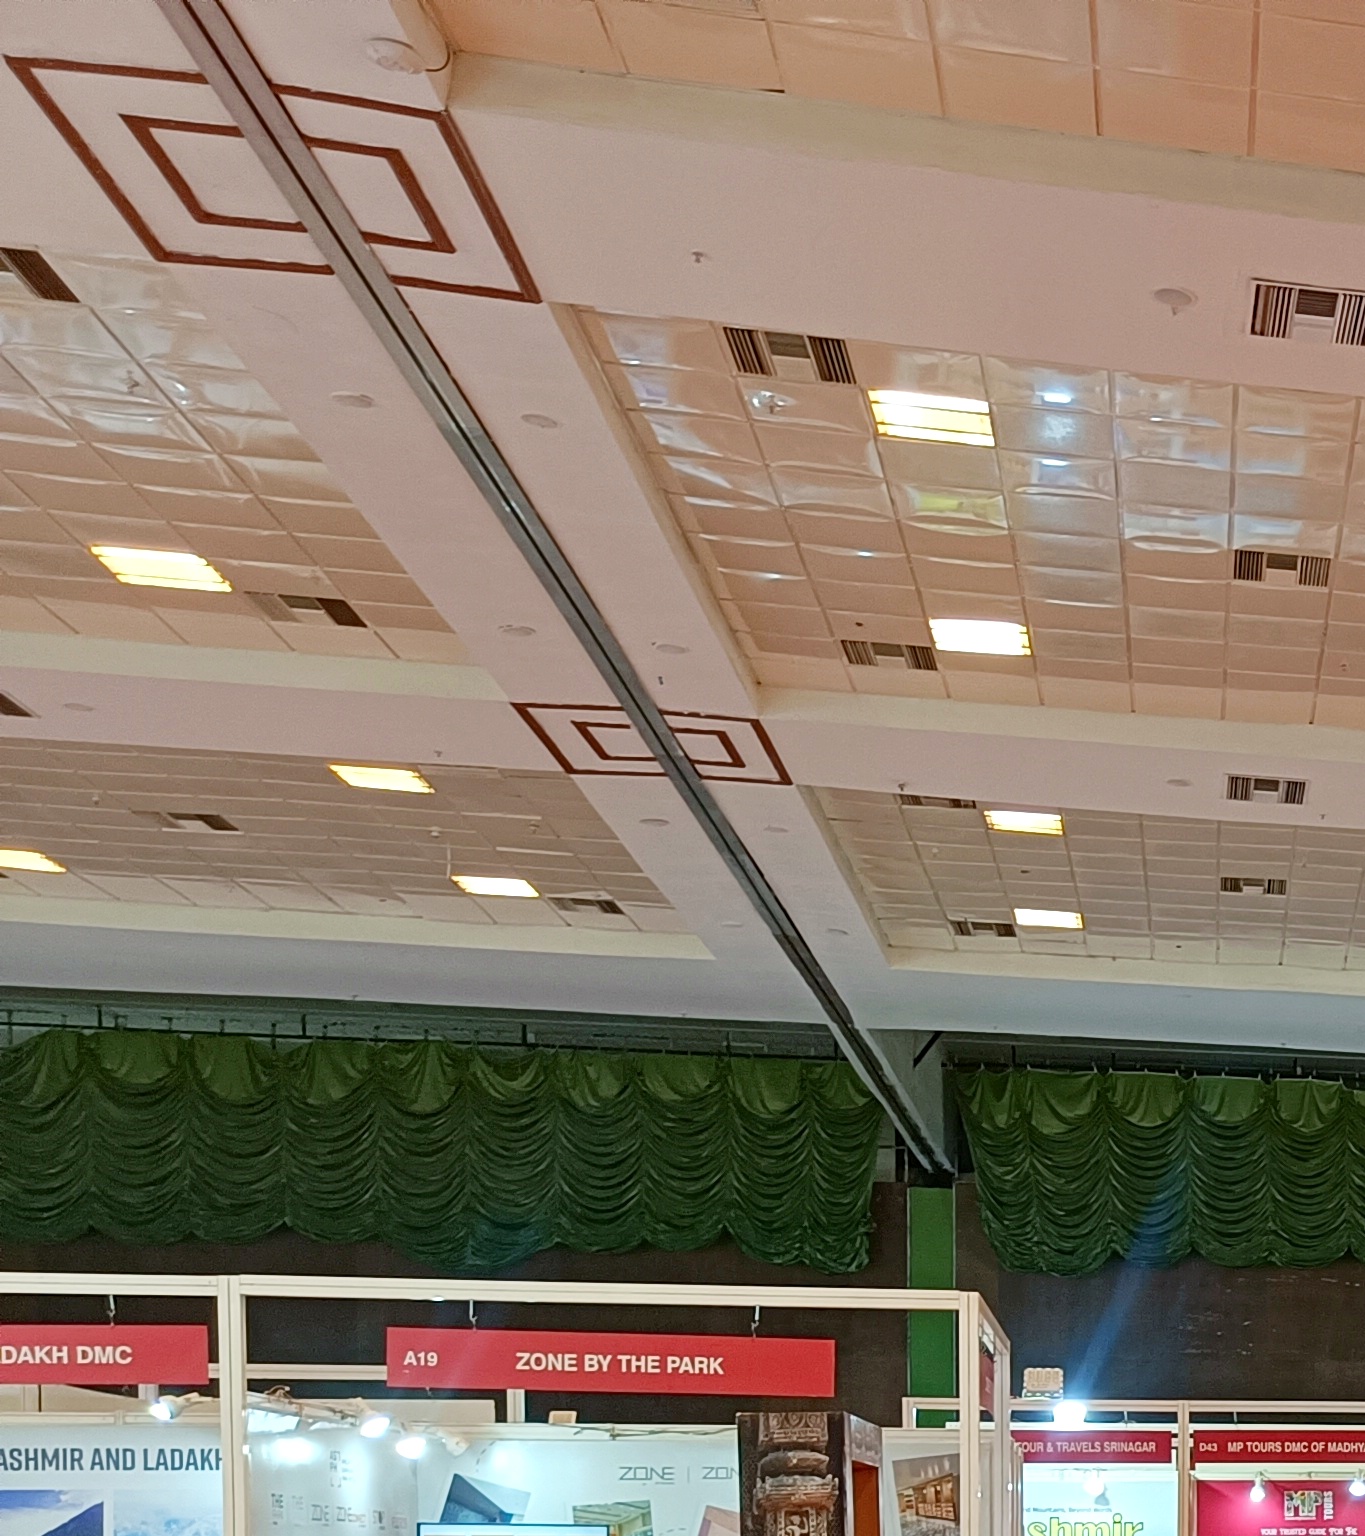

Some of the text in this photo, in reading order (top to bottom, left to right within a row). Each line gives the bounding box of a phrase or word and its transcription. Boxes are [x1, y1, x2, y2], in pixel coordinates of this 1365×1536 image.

[0, 1345, 134, 1365] DAKH DMC
[403, 1350, 725, 1376] A19 ZONE BY THE PARK
[1046, 1441, 1054, 1453] &
[1056, 1441, 1101, 1453] TRAVELS
[1103, 1441, 1157, 1453] SRINAGAR
[1199, 1443, 1218, 1452] D43
[1227, 1442, 1244, 1453] MP
[1246, 1442, 1283, 1453] TOURS
[1284, 1442, 1309, 1453] DMC
[1310, 1442, 1326, 1453] OF
[90, 1448, 136, 1472] AND
[618, 1466, 676, 1481] ZONE
[1283, 1490, 1334, 1520] MP TOURS
